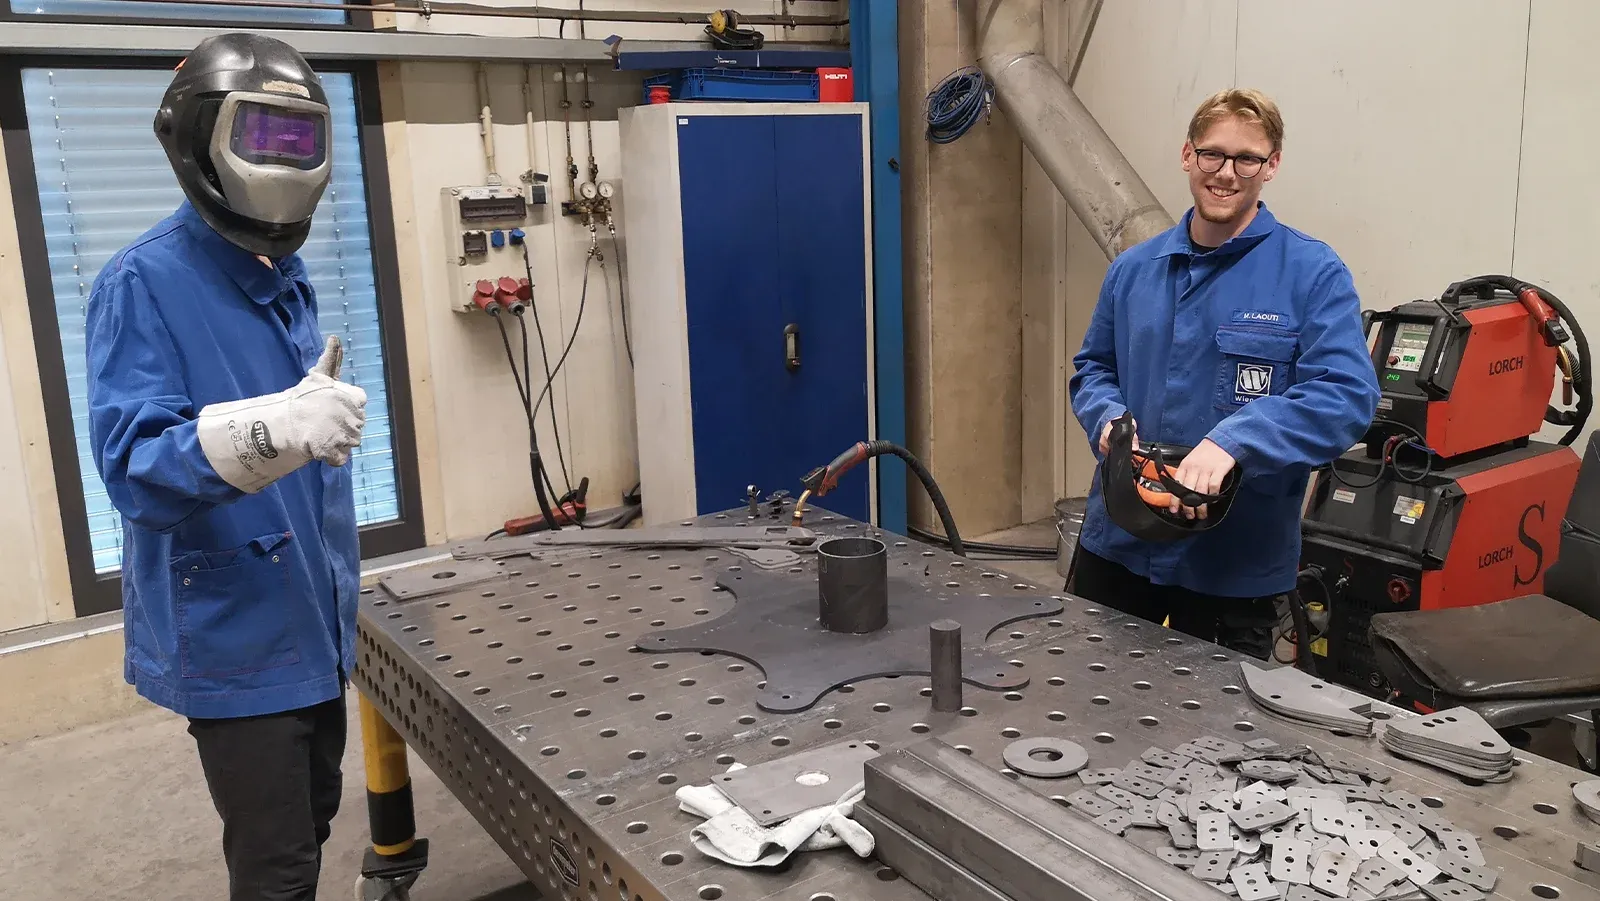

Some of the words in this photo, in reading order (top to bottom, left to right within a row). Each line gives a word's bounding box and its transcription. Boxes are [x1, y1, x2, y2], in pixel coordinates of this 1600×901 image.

[1251, 313, 1279, 321] LAOUTI
[1488, 355, 1524, 376] LORCH
[254, 421, 278, 459] STRONG
[1478, 545, 1514, 569] LORCH
[1513, 500, 1546, 591] S
